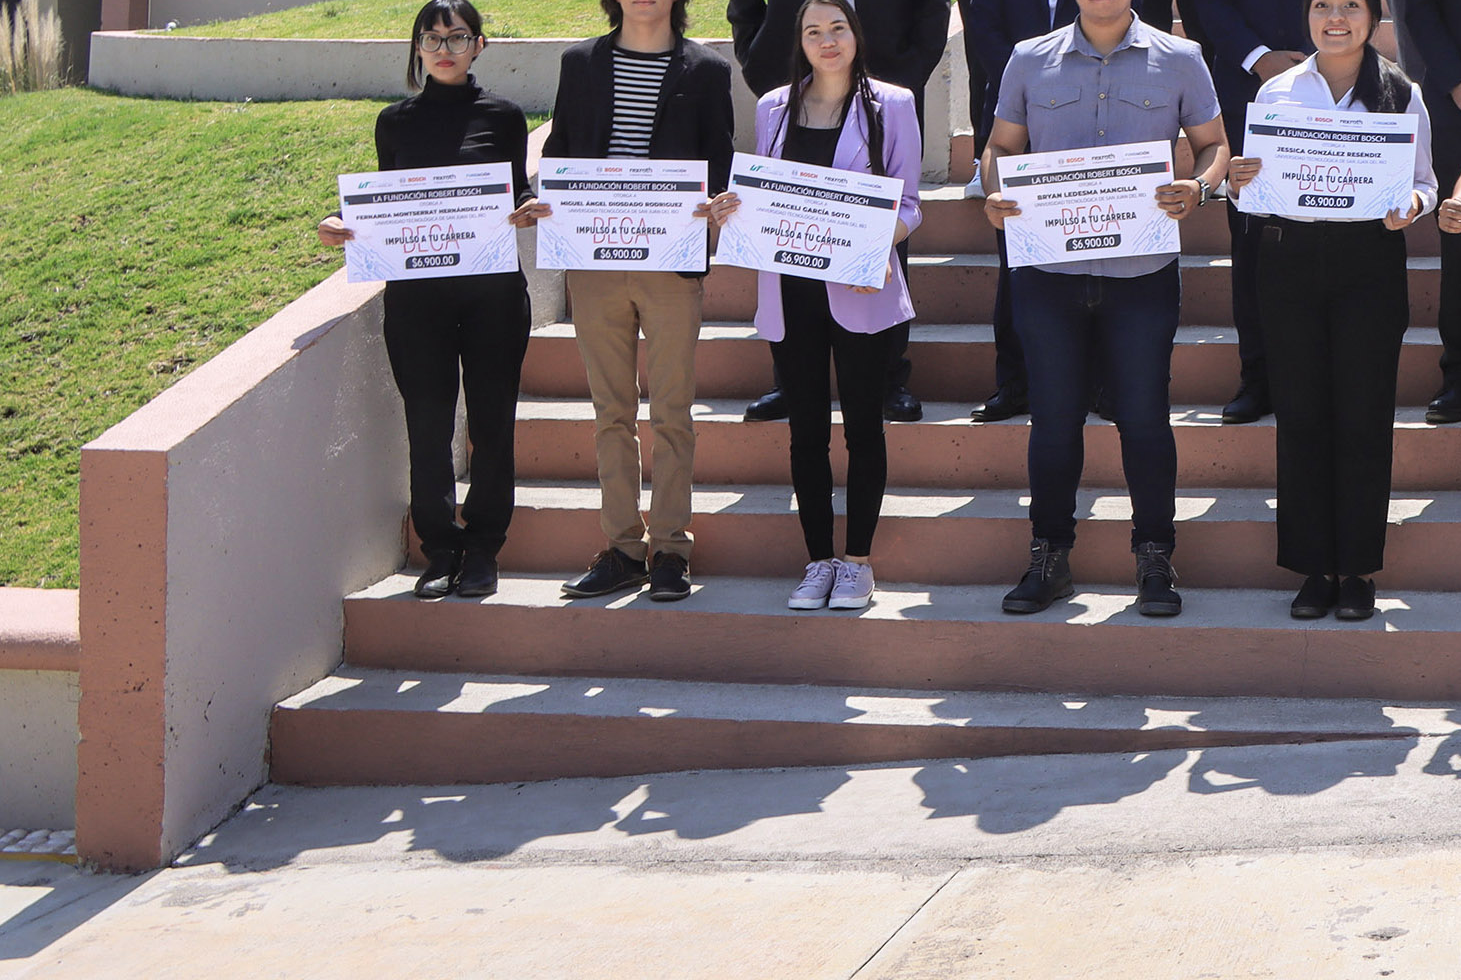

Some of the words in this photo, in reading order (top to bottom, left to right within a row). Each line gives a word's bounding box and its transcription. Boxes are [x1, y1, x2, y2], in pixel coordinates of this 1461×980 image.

[1287, 130, 1330, 139] FUNDACIÓN
[1332, 132, 1360, 141] ROBERT
[1361, 134, 1386, 142] BOSCH
[1307, 148, 1345, 156] GONZÁLEZ
[1031, 176, 1041, 184] LA
[1042, 171, 1085, 183] FUNDACIÓN
[1086, 169, 1114, 178] ROBERT
[1115, 167, 1141, 175] BOSCH
[1298, 163, 1357, 193] BECA
[383, 191, 426, 201] FUNDACIÓN
[427, 190, 455, 198] ROBERT
[456, 187, 481, 196] BOSCH
[579, 182, 621, 190] FUNDACIÓN
[760, 181, 770, 189] LA
[770, 183, 814, 196] FUNDACIÓN
[814, 190, 843, 201] ROBERT
[843, 194, 869, 205] BOSCH
[1037, 192, 1062, 200] BRYAN
[1063, 189, 1098, 197] LEDESMA
[1099, 185, 1137, 194] MANCILLA
[1304, 195, 1348, 208] $6,900.00
[770, 201, 801, 211] ARACELI
[802, 206, 829, 216] GARCÍA
[830, 211, 850, 219] SOTO
[1061, 202, 1120, 235] BECA
[401, 222, 460, 253] BECA
[593, 216, 650, 244] BECA
[775, 218, 837, 255] BECA
[1071, 235, 1115, 250] $6,900.00
[411, 254, 454, 268] $6,900.00
[600, 248, 642, 259] $6,900.00
[780, 251, 824, 268] $6,900.00
